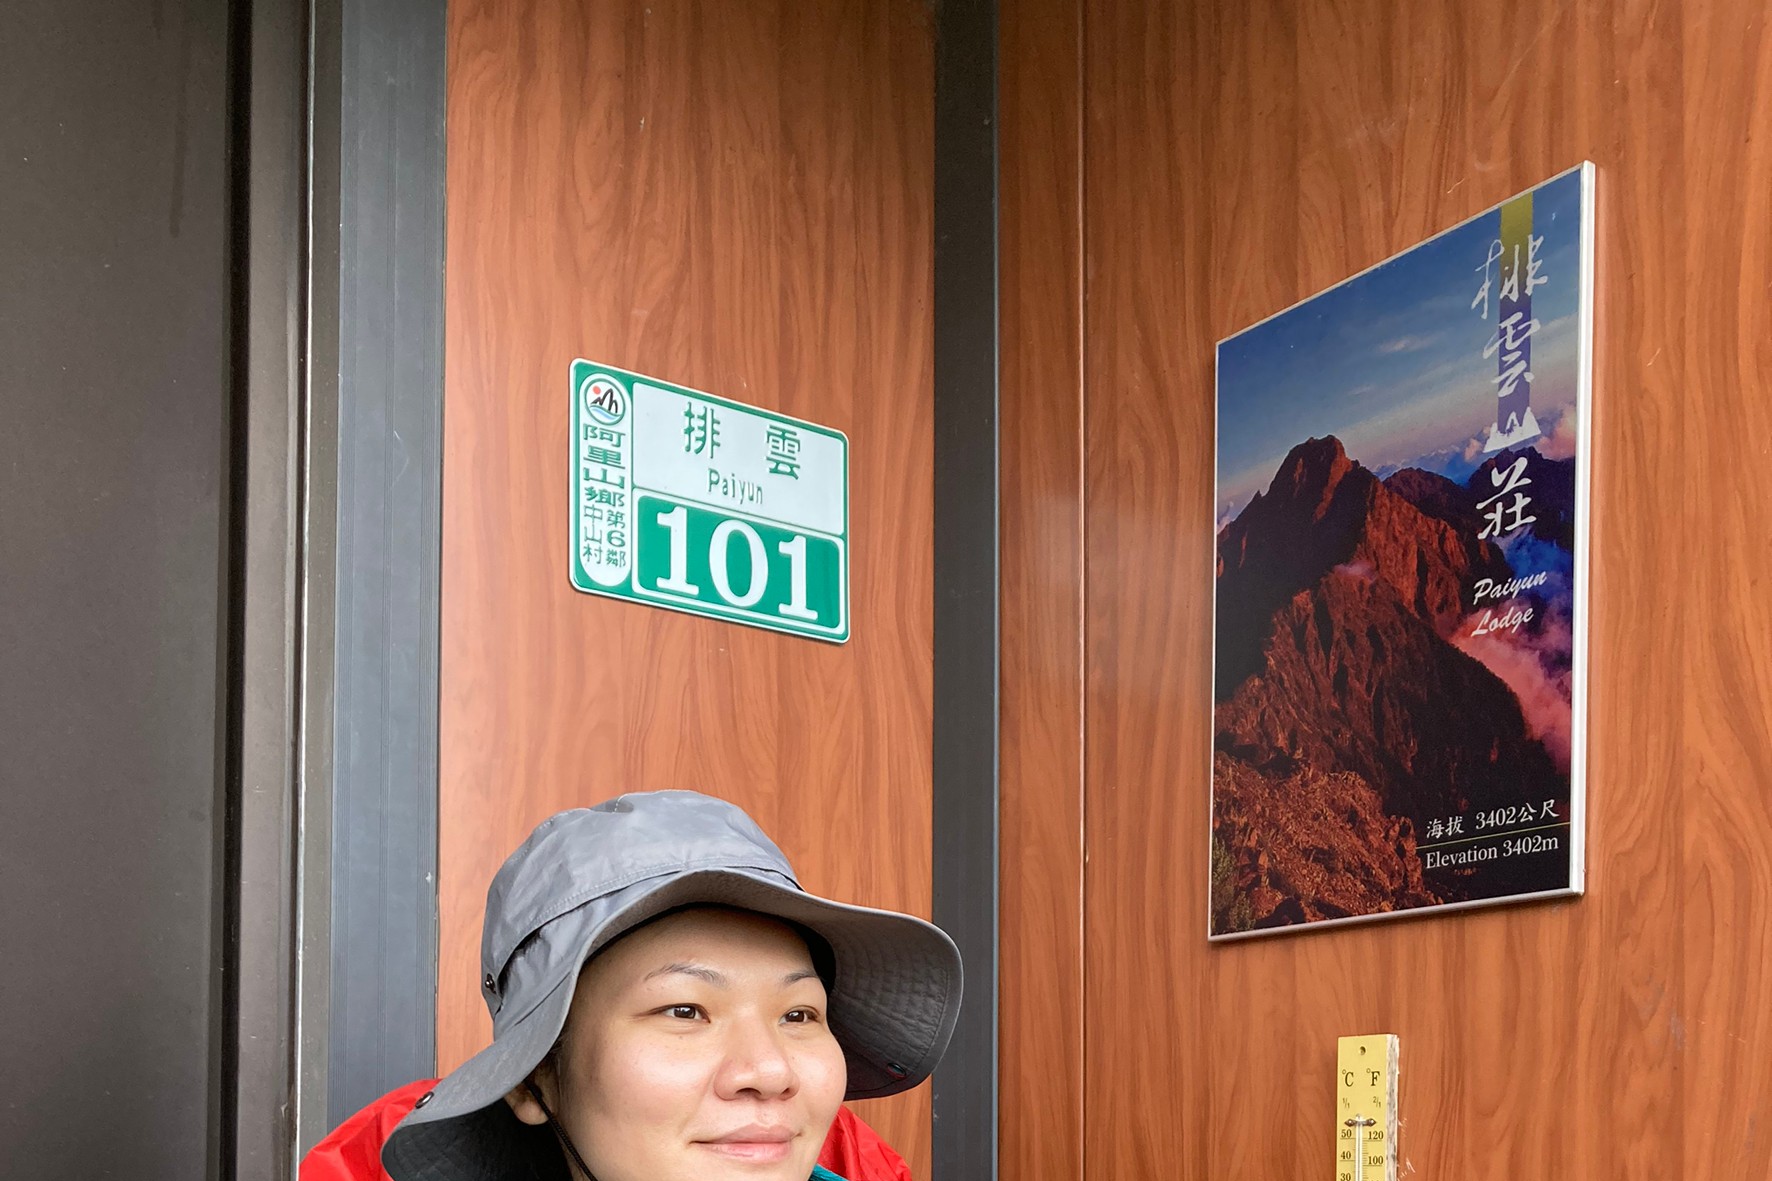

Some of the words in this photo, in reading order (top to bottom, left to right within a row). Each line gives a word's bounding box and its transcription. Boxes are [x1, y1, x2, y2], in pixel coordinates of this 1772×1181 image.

[683, 401, 801, 480] 排雲
[582, 422, 627, 508] 阿里山鄉
[708, 467, 763, 505] Paiyun
[656, 505, 819, 621] 101
[1472, 570, 1548, 606] Paiyun
[1470, 606, 1535, 638] Lodge
[1426, 815, 1465, 840] 海拔
[1475, 798, 1561, 830] 3402公尺
[1425, 845, 1498, 870] Elevation
[1502, 834, 1560, 858] 3402m
[1341, 1129, 1352, 1138] 50
[1368, 1131, 1383, 1140] 120
[1340, 1151, 1351, 1160] 40
[1368, 1156, 1383, 1165] 100
[1340, 1173, 1351, 1181] 30
